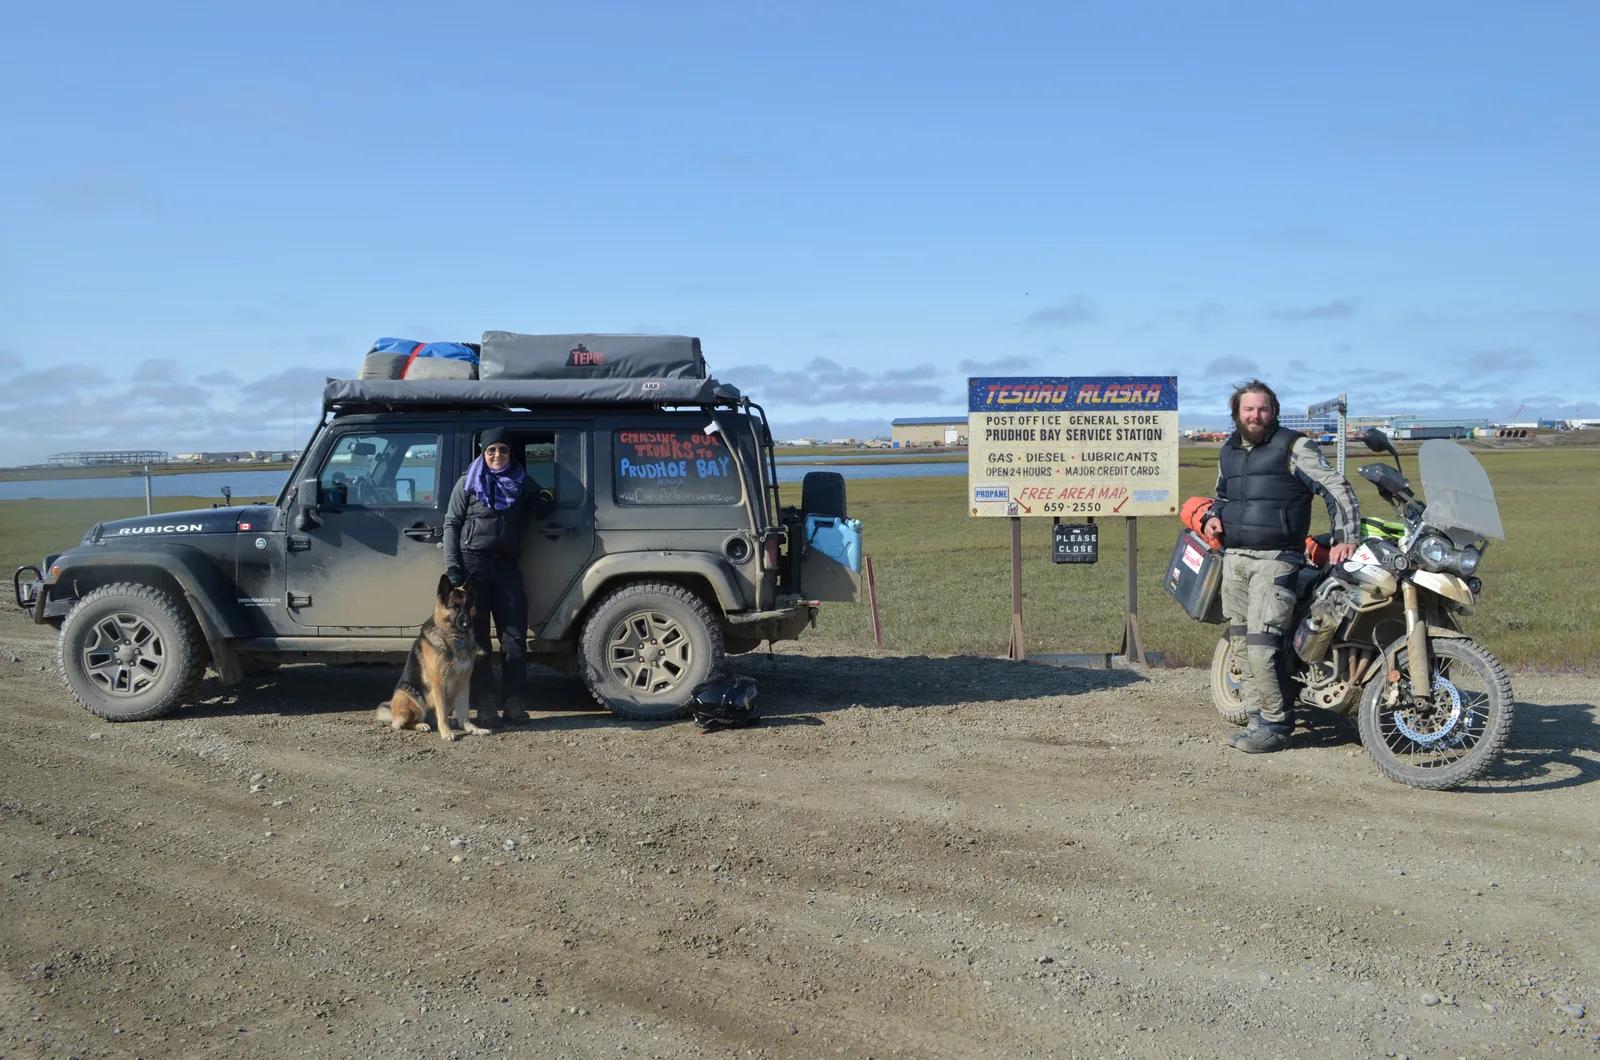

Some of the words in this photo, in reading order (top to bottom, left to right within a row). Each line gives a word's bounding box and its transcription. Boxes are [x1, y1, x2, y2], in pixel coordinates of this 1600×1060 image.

[986, 385, 1068, 404] TESORO
[1076, 384, 1162, 404] ALASKA
[986, 416, 1014, 426] POST
[1018, 415, 1061, 425] OFFICE
[1069, 415, 1119, 425] GENERAL
[1123, 415, 1159, 425] STORE
[985, 429, 1036, 441] PRUDHOE
[1040, 429, 1061, 441] BAY
[1066, 429, 1112, 441] SERVICE
[1116, 428, 1162, 441] STATION
[988, 453, 1013, 463] GAS
[1026, 453, 1066, 463] DIESEL
[1081, 452, 1158, 462] LUBRICANTS
[696, 456, 729, 478] BAY
[985, 467, 1009, 477] OPEN
[1010, 467, 1022, 476] 24
[1023, 467, 1052, 476] HOURS
[1065, 466, 1095, 476] MAJOR
[1097, 466, 1128, 476] CREDIT
[1130, 466, 1160, 476] CARDS
[975, 490, 1008, 498] PROPANE
[1020, 487, 1055, 500] FREE
[1058, 487, 1094, 500] AREA
[1098, 487, 1128, 500] MAP
[119, 524, 202, 535] RUBICON
[1056, 534, 1097, 542] PLEASE
[1059, 545, 1093, 553] CLOSE
